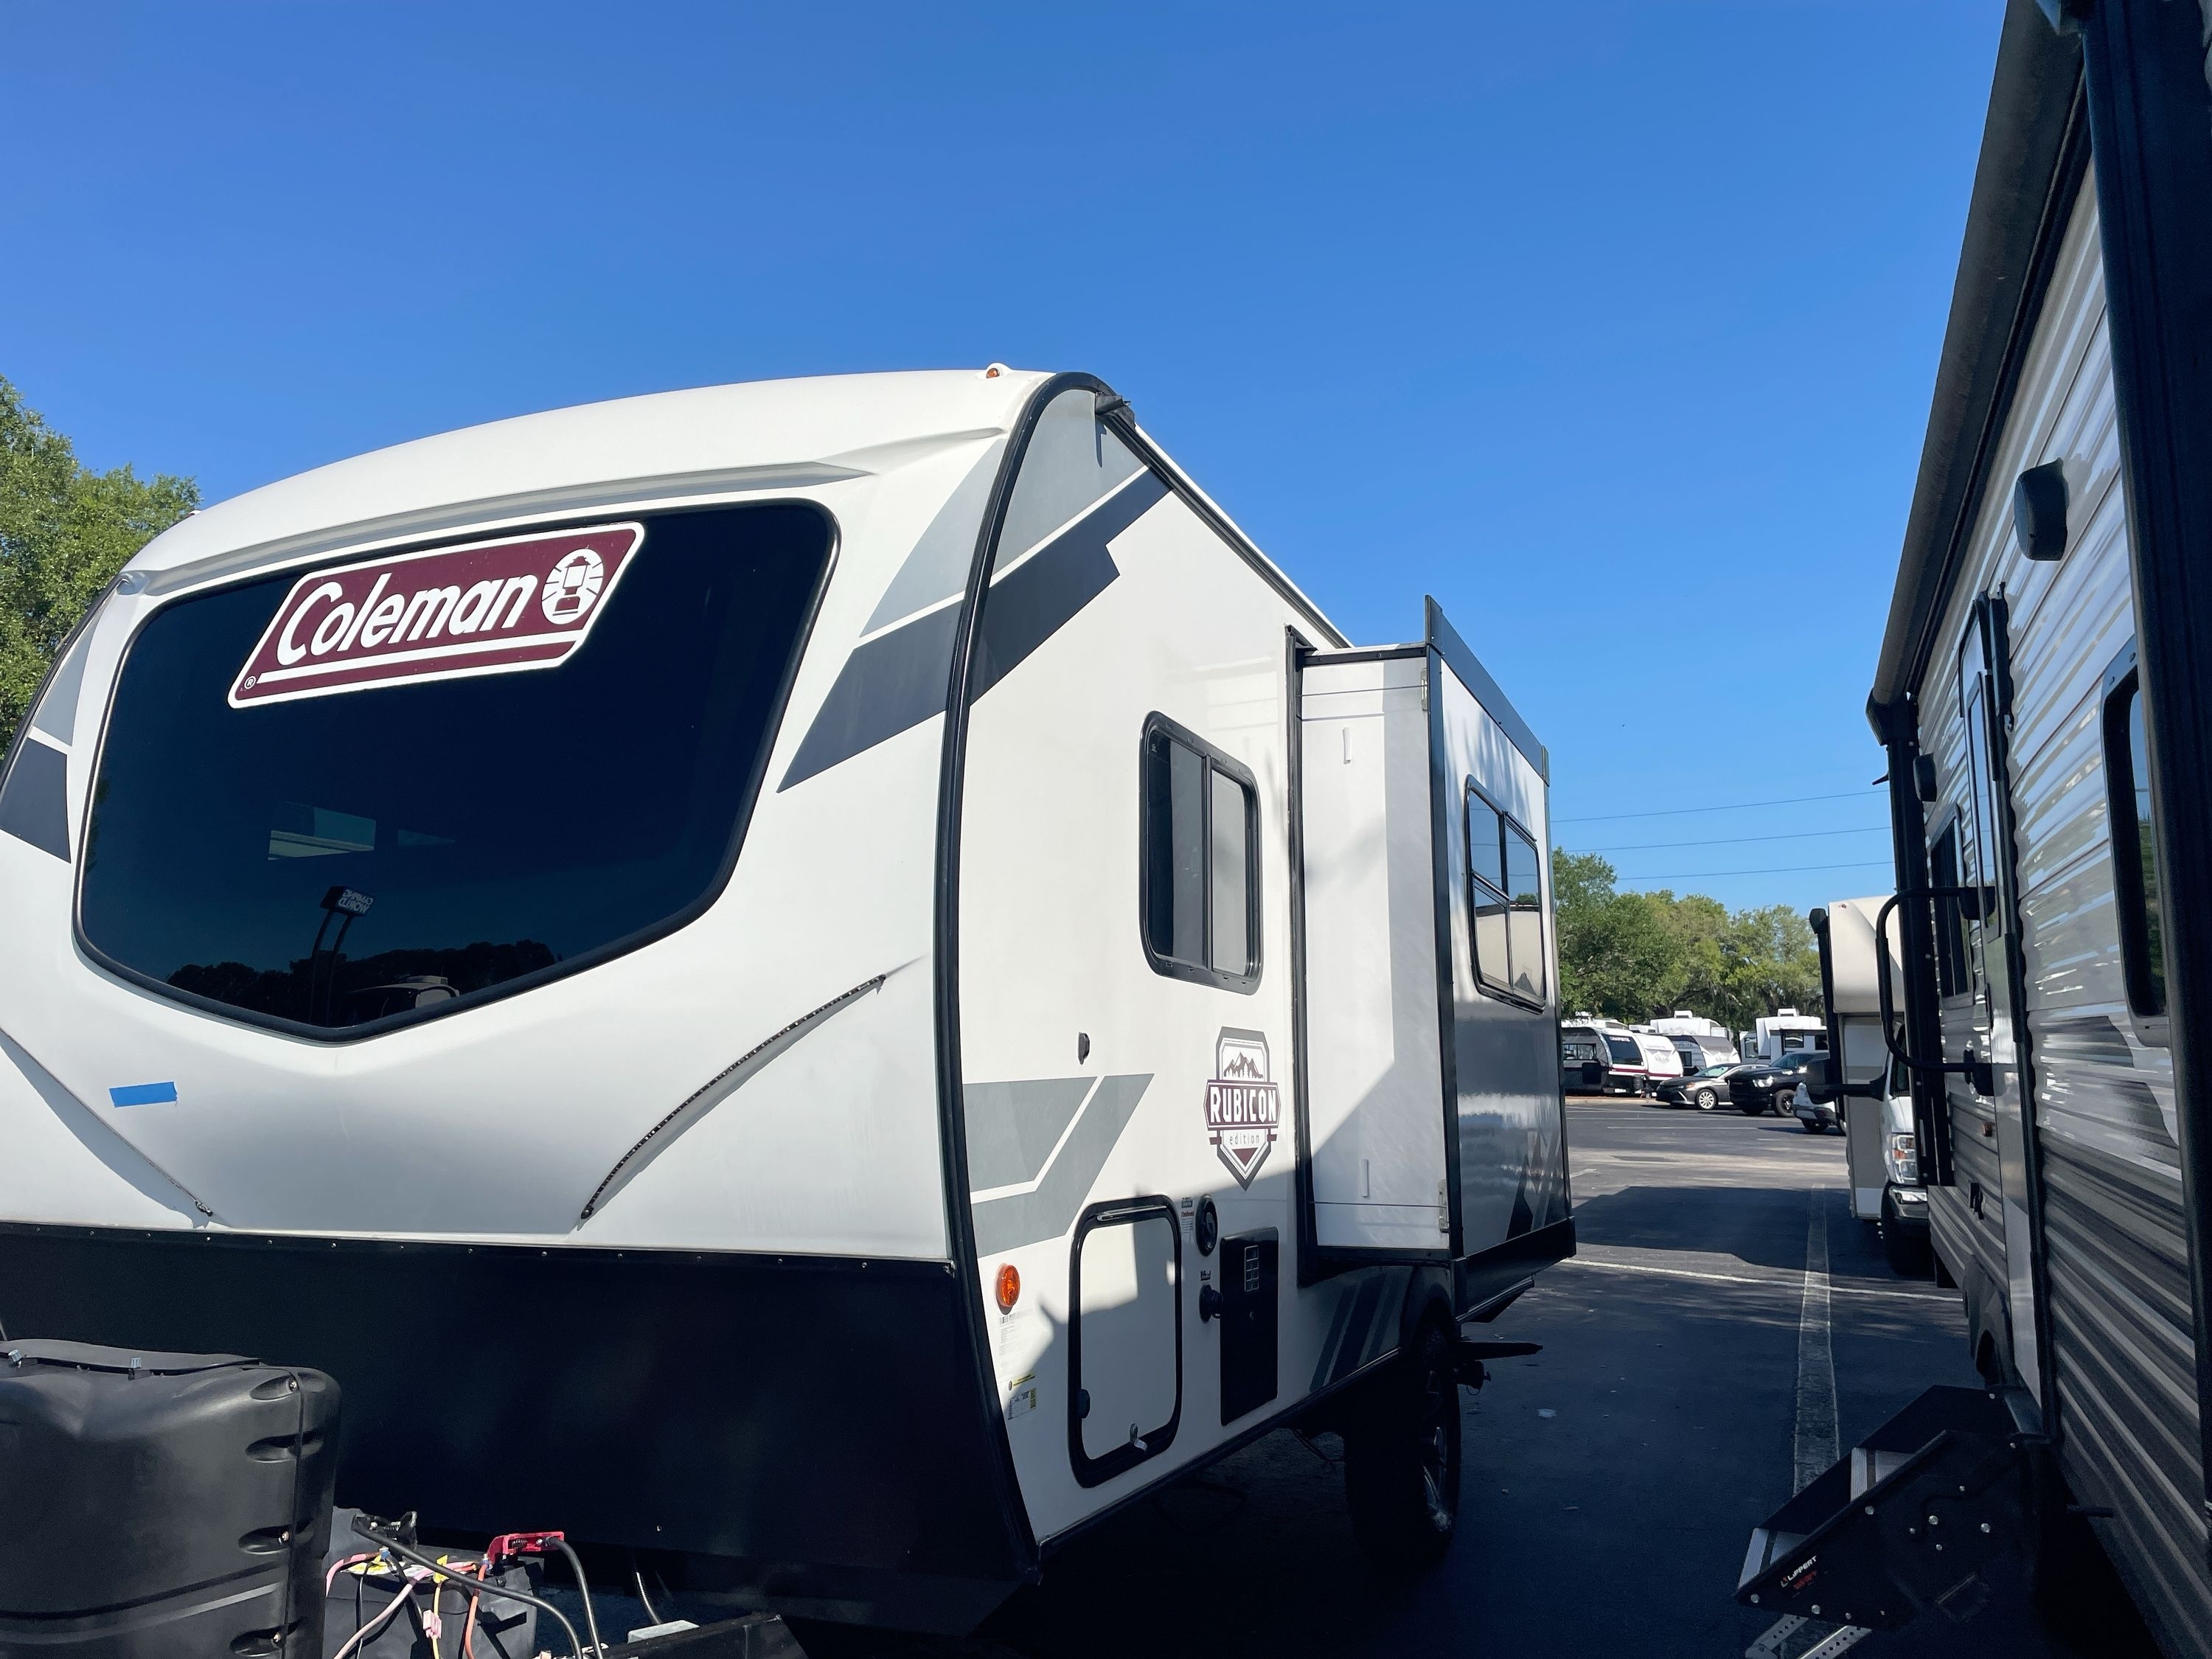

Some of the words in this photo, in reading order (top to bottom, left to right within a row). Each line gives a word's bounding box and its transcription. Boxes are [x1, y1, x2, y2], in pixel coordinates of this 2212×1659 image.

[276, 572, 538, 666] Coleman
[1210, 1086, 1276, 1123] RUBICON
[1229, 1133, 1260, 1145] edition
